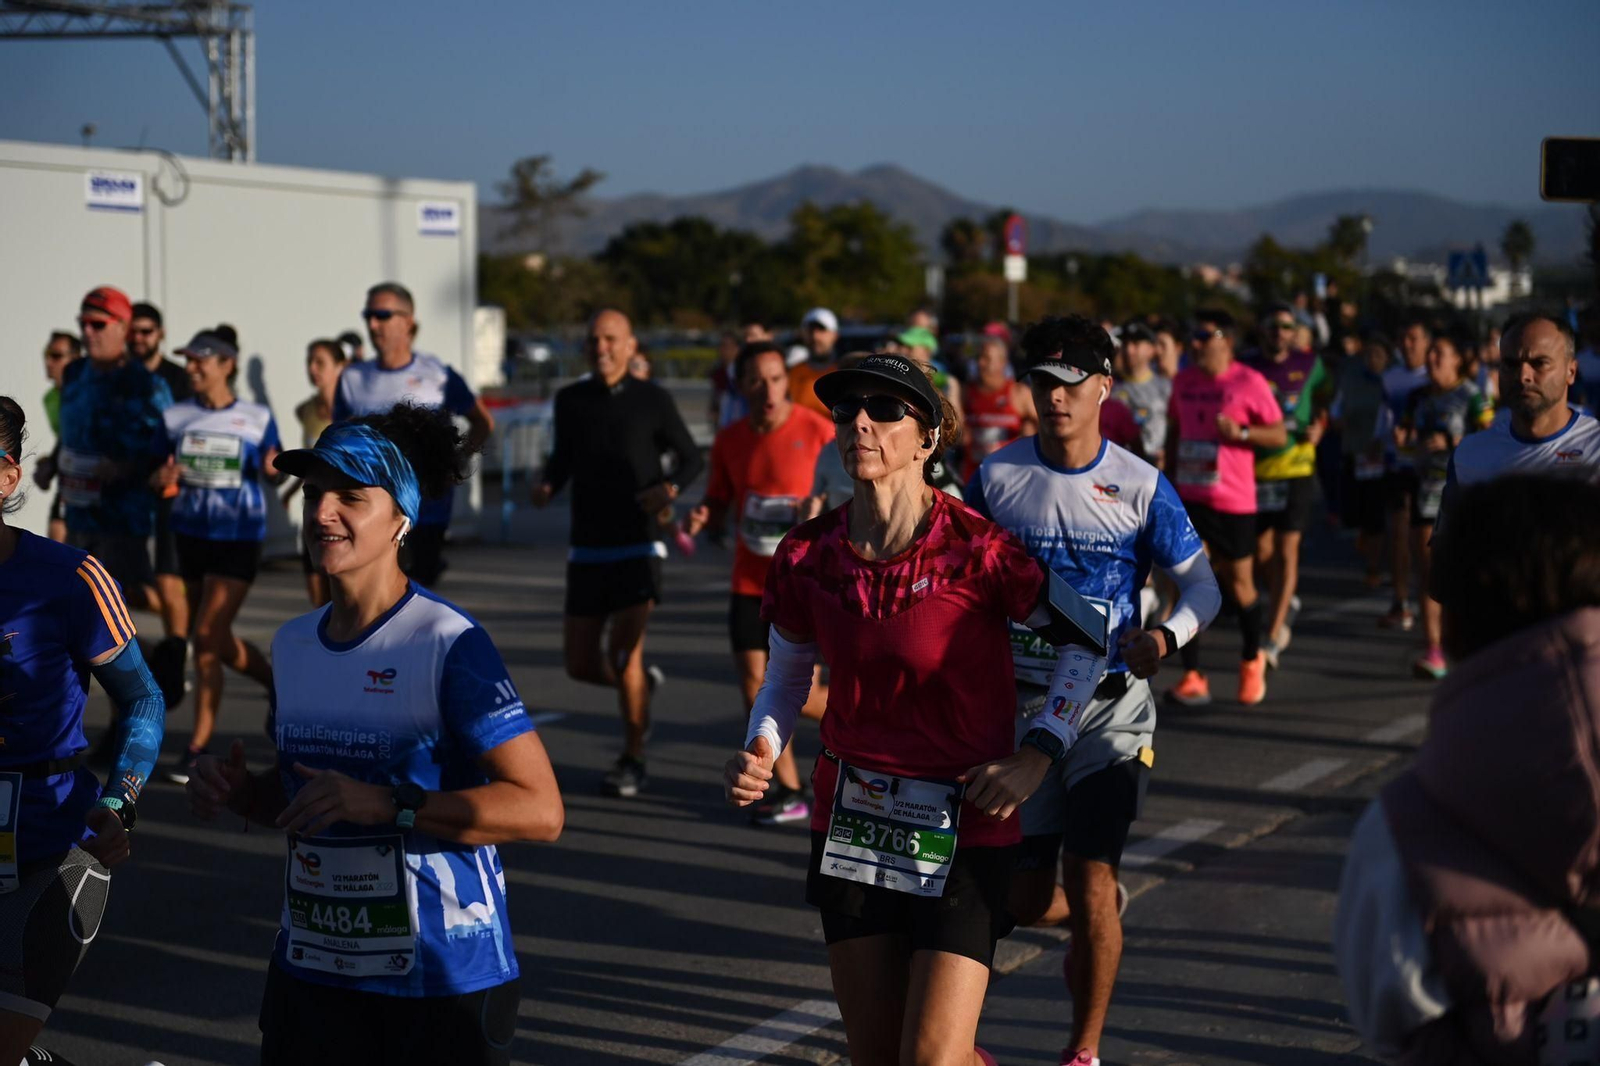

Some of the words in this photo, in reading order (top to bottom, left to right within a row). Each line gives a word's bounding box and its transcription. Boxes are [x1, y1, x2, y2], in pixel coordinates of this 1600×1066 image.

[287, 724, 377, 746] TotalEnergies
[298, 743, 335, 755] MARATÓN
[336, 745, 375, 760] MÁLAGA
[378, 731, 391, 760] 2022
[905, 801, 938, 813] MARATÓN
[893, 808, 902, 816] DE
[903, 808, 931, 821] MÁLAGA
[860, 820, 921, 856] 3766
[880, 854, 897, 865] BRS
[343, 871, 380, 882] MARATÓN
[333, 884, 342, 892] DE
[343, 882, 374, 892] MÁLAGA
[310, 902, 373, 934] 4484
[377, 924, 408, 936] málaga
[323, 937, 361, 950] ANALENA
